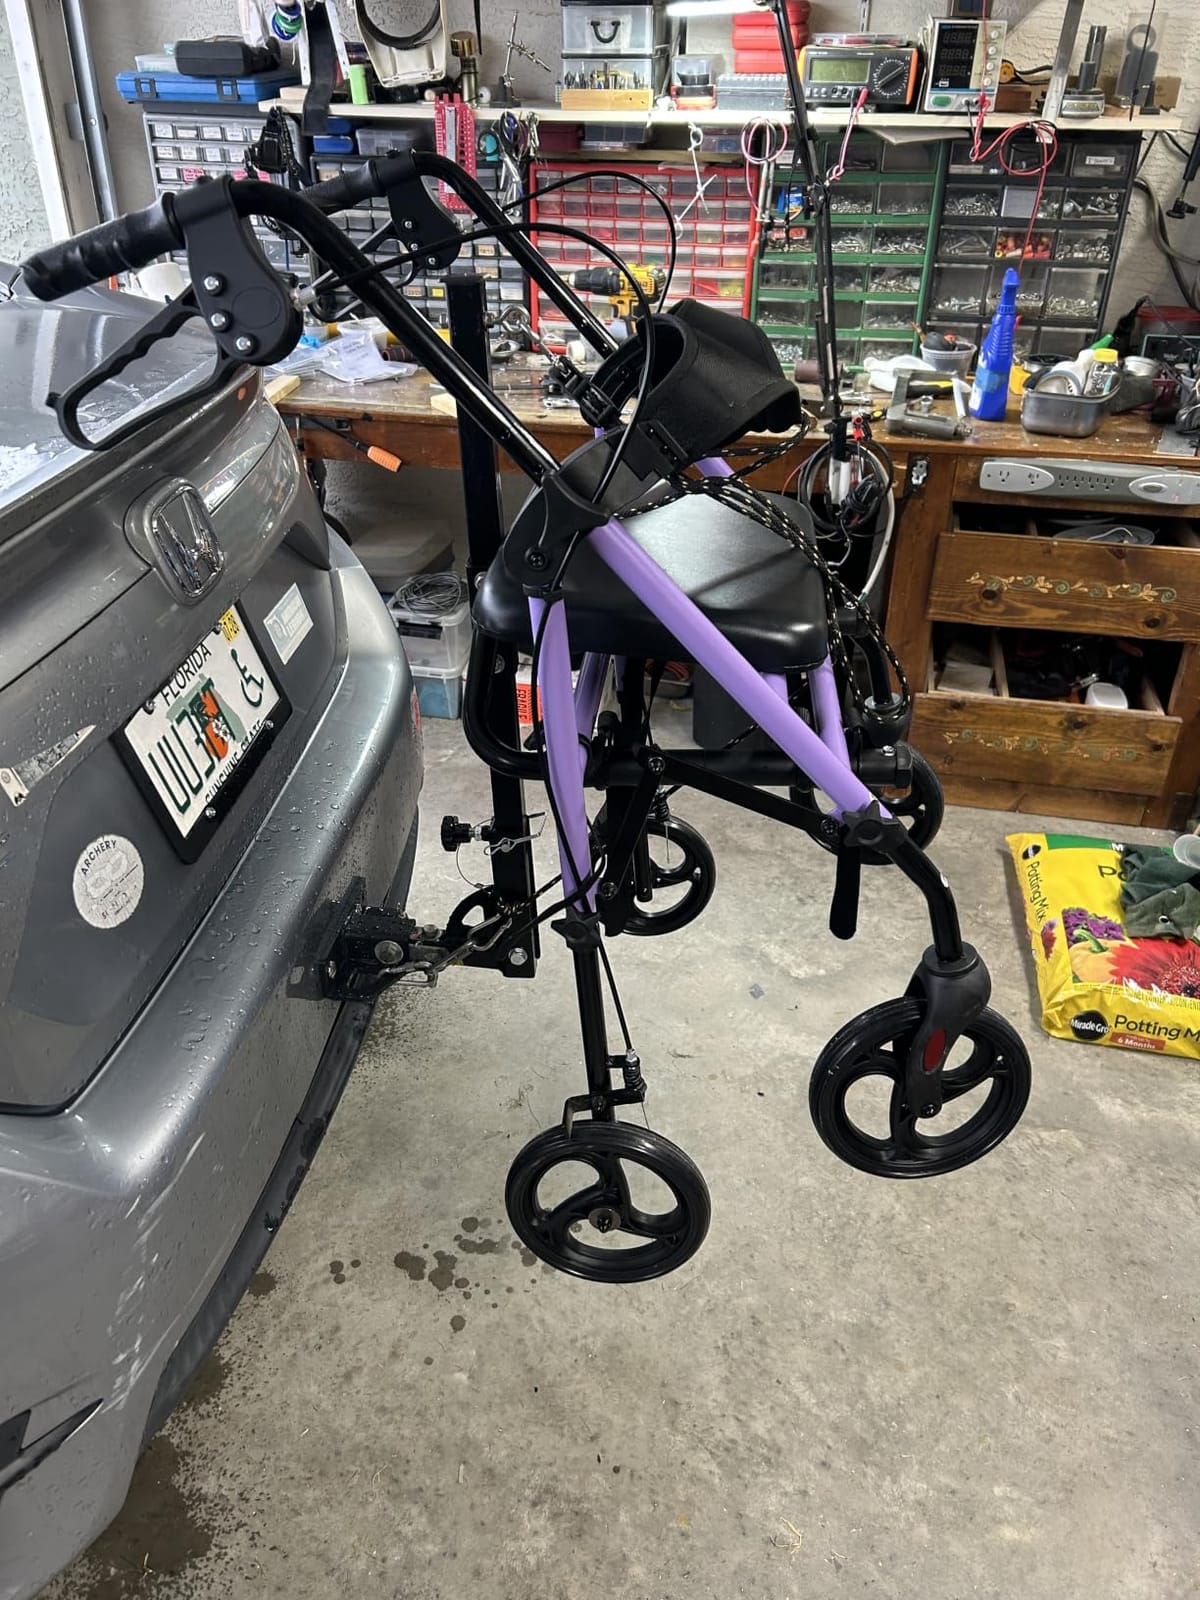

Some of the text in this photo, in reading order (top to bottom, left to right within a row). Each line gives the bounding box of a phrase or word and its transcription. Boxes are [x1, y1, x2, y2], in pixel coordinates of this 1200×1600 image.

[160, 644, 212, 707] FLORIDA
[81, 839, 117, 876] ARCHERY
[1027, 861, 1043, 903] Potting
[1033, 897, 1049, 923] Mix
[1114, 1014, 1181, 1040] Potting
[1125, 1038, 1156, 1049] Months
